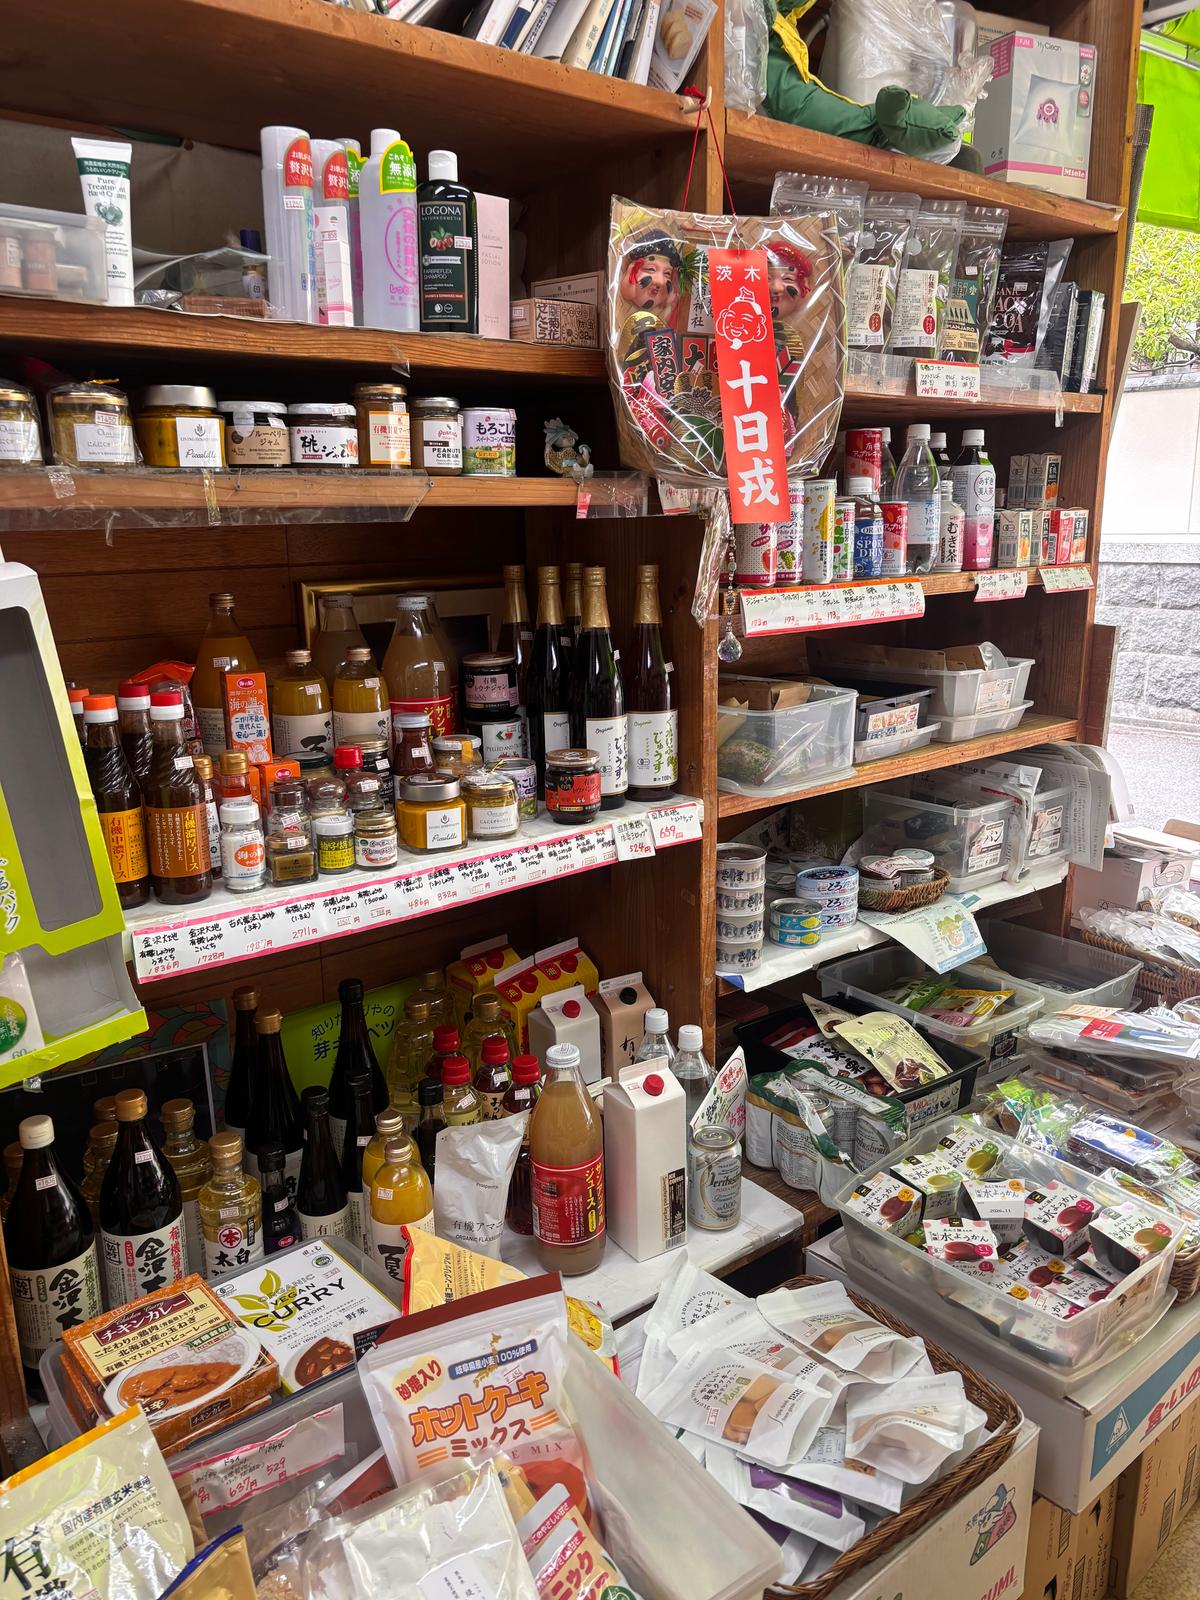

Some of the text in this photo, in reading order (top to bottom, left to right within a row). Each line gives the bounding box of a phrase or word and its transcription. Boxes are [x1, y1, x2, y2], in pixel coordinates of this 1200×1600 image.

[1037, 39, 1063, 53] HyClean
[1063, 168, 1087, 179] Miele
[421, 206, 461, 216] LOGONA
[715, 265, 761, 281] 茨木
[249, 430, 288, 438] ルーベリー
[726, 360, 781, 507] 十日戎
[300, 434, 320, 454] 桃
[977, 475, 996, 486] あずき
[946, 521, 959, 563] むぎ茶
[482, 676, 498, 684] 有機
[614, 736, 624, 781] じゅうす
[653, 730, 665, 775] じゅうす
[183, 811, 200, 871] 有機濃厚ソース
[659, 825, 684, 840] 659円
[109, 816, 128, 879] 有機中濃ソース
[629, 842, 652, 853] 524円
[408, 897, 430, 910] 486円
[142, 932, 180, 949] 金沢大地
[188, 923, 222, 939] 金沢大地
[291, 926, 319, 940] 2711円
[148, 960, 181, 975] 1836円
[197, 951, 226, 965] 1728円
[953, 1138, 985, 1165] 水ようかん
[916, 1163, 950, 1180] 水ようかん
[585, 1167, 597, 1210] ジュース
[866, 1183, 901, 1214] 水ようかん
[982, 1187, 1021, 1200] 水ようかん
[1043, 1193, 1080, 1219] 水ようかん
[451, 1219, 504, 1234] 有機アマニ
[1119, 1216, 1156, 1236] 水ようかん
[455, 1233, 476, 1242] ORGANIC
[939, 1233, 991, 1243] 水ようかん
[215, 1248, 251, 1268] 太白
[1013, 1254, 1051, 1280] 水ようかん
[49, 1268, 86, 1341] 金沢大
[253, 1277, 346, 1329] CURRY
[270, 1283, 316, 1307] VEGAN
[100, 1298, 188, 1342] チキンカレー
[117, 1314, 198, 1358] 北海道産の玉ねぎ
[395, 1358, 442, 1401] 砂糖入り
[718, 1387, 742, 1407] Plain
[409, 1370, 550, 1448] ホットケーキ
[449, 1417, 532, 1459] ミックス
[531, 1440, 564, 1456] MIX
[266, 1456, 286, 1476] 529
[229, 1478, 258, 1499] 637円
